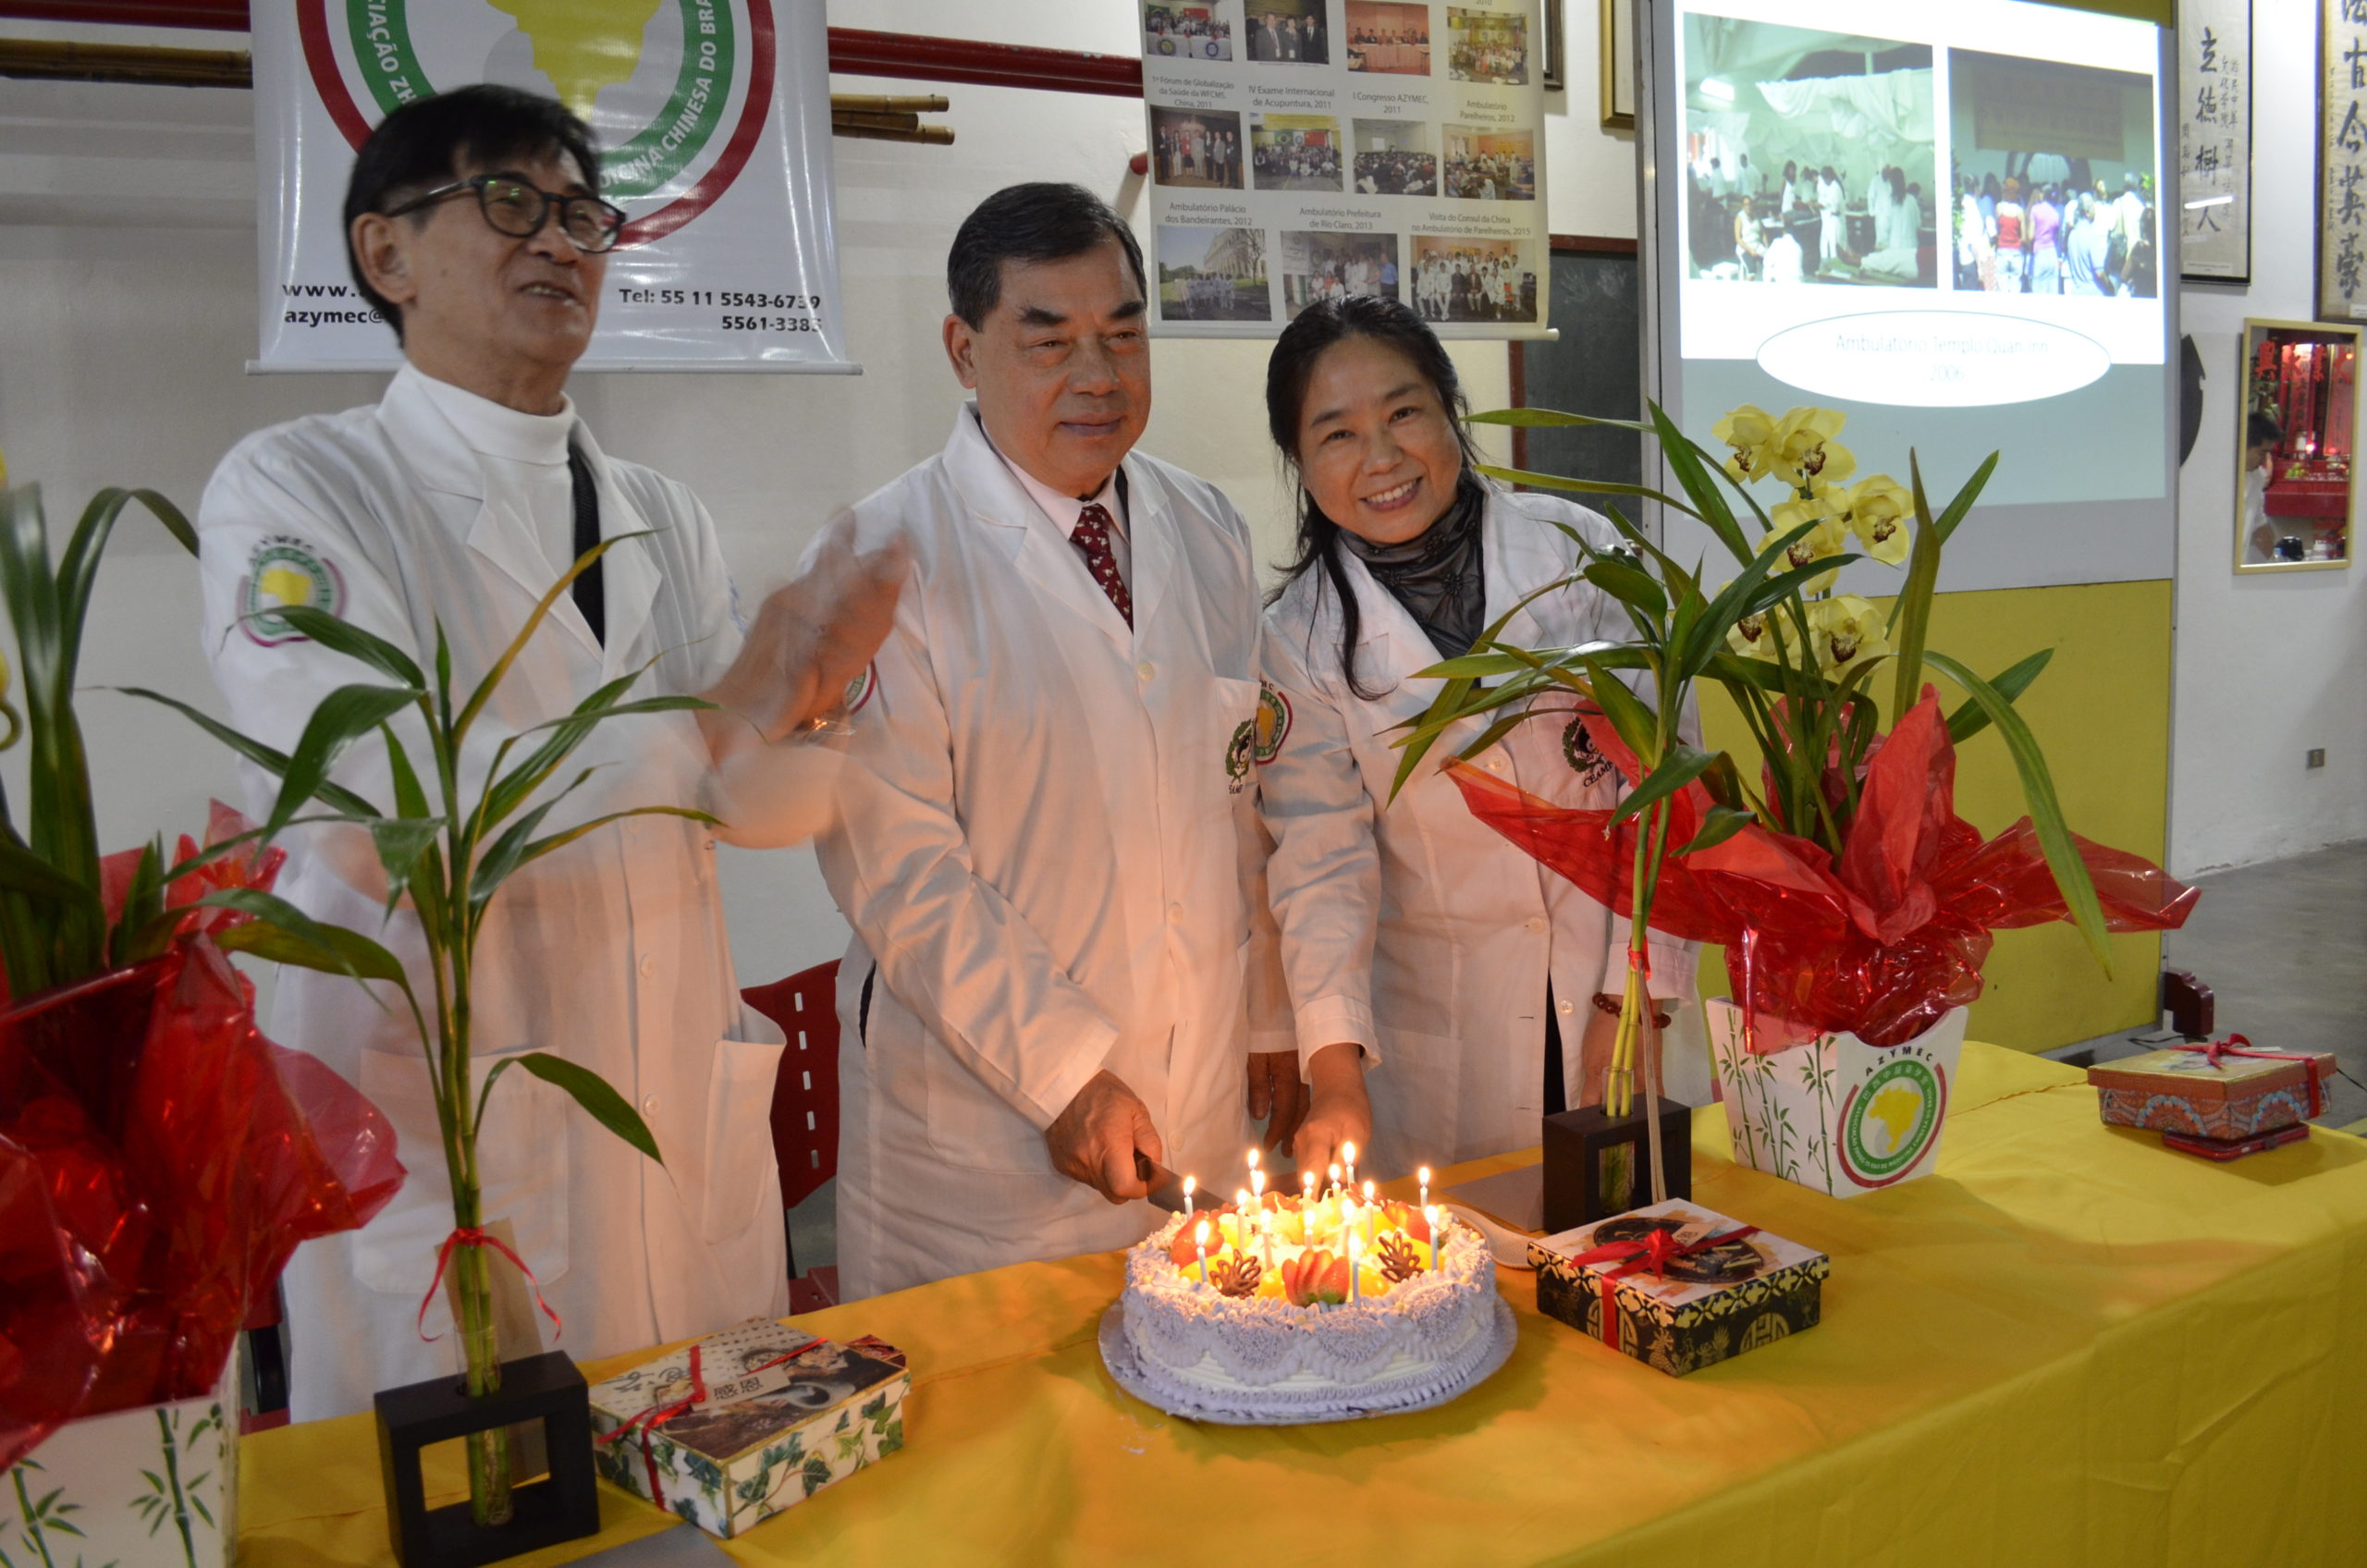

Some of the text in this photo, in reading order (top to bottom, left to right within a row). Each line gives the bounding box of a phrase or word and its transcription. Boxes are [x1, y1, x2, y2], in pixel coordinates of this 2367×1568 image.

[366, 0, 399, 72] IAÇÃO
[1160, 76, 1183, 86] Fórum
[1184, 78, 1193, 86] de
[1193, 79, 1234, 91] Globalização
[661, 77, 712, 152] CHINESA
[699, 42, 717, 71] DO
[1159, 87, 1168, 95] da
[1169, 88, 1190, 97] Saúde
[1191, 90, 1199, 98] da
[1248, 86, 1335, 98] IV Exame Internacional
[1196, 100, 1212, 108] 2011
[1253, 98, 1331, 110] de Acupuntura, 2011
[1356, 93, 1396, 104] Congresso
[1383, 105, 1401, 114] 2011
[1466, 100, 1507, 111] Ambulatório
[1498, 113, 1515, 122] 2012
[1170, 202, 1246, 214] Ambulatório Palácio
[1299, 207, 1381, 219] Ambulatório Prefeitura
[1165, 215, 1252, 227] dos Bandeirantes, 2012
[1429, 212, 1446, 222] Visita
[1447, 214, 1456, 222] do
[1482, 214, 1490, 224] da
[1491, 215, 1511, 225] China
[1309, 220, 1373, 230] de Rio Claro, 2013
[1421, 224, 1463, 233] Ambulatório
[1464, 226, 1473, 234] de
[1513, 227, 1531, 236] 2015
[282, 284, 356, 297] www.
[619, 288, 821, 310] Tel: 55 11 5543-6739
[284, 308, 384, 328] azymec@
[1865, 1047, 1932, 1077] AZYMEC
